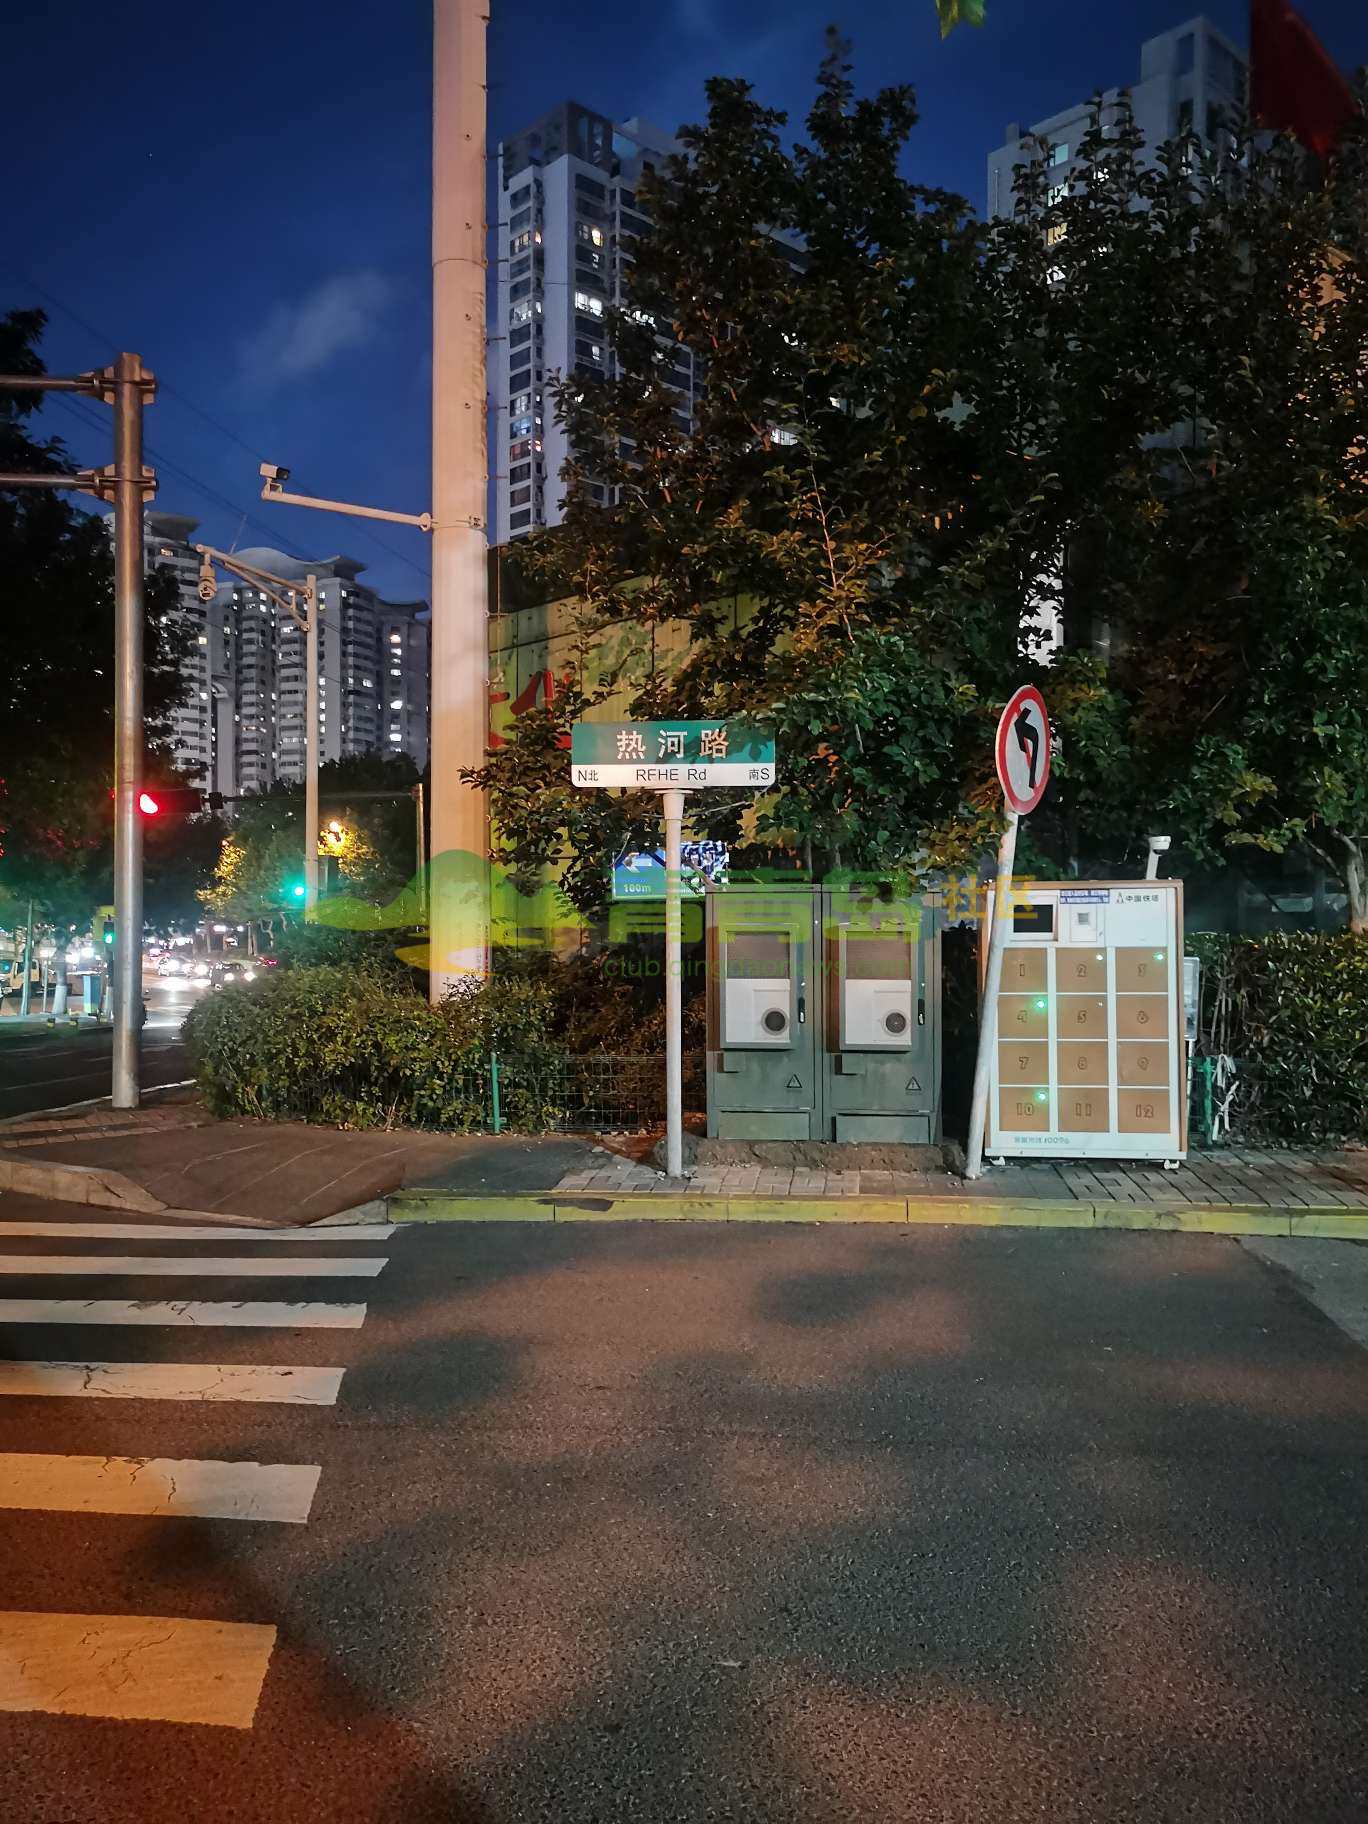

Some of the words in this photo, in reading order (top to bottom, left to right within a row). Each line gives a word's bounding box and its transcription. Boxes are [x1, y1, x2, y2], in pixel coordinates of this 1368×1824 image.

[616, 729, 729, 760] 热河路
[687, 768, 707, 781] Rd
[1019, 963, 1026, 977] 1
[1076, 963, 1087, 978] 2
[1018, 1056, 1030, 1070] 7
[1077, 1056, 1088, 1070] 8
[1137, 1056, 1149, 1071] 9
[1016, 1102, 1034, 1116] 10
[1075, 1102, 1092, 1117] 11
[1135, 1104, 1154, 1118] 12
